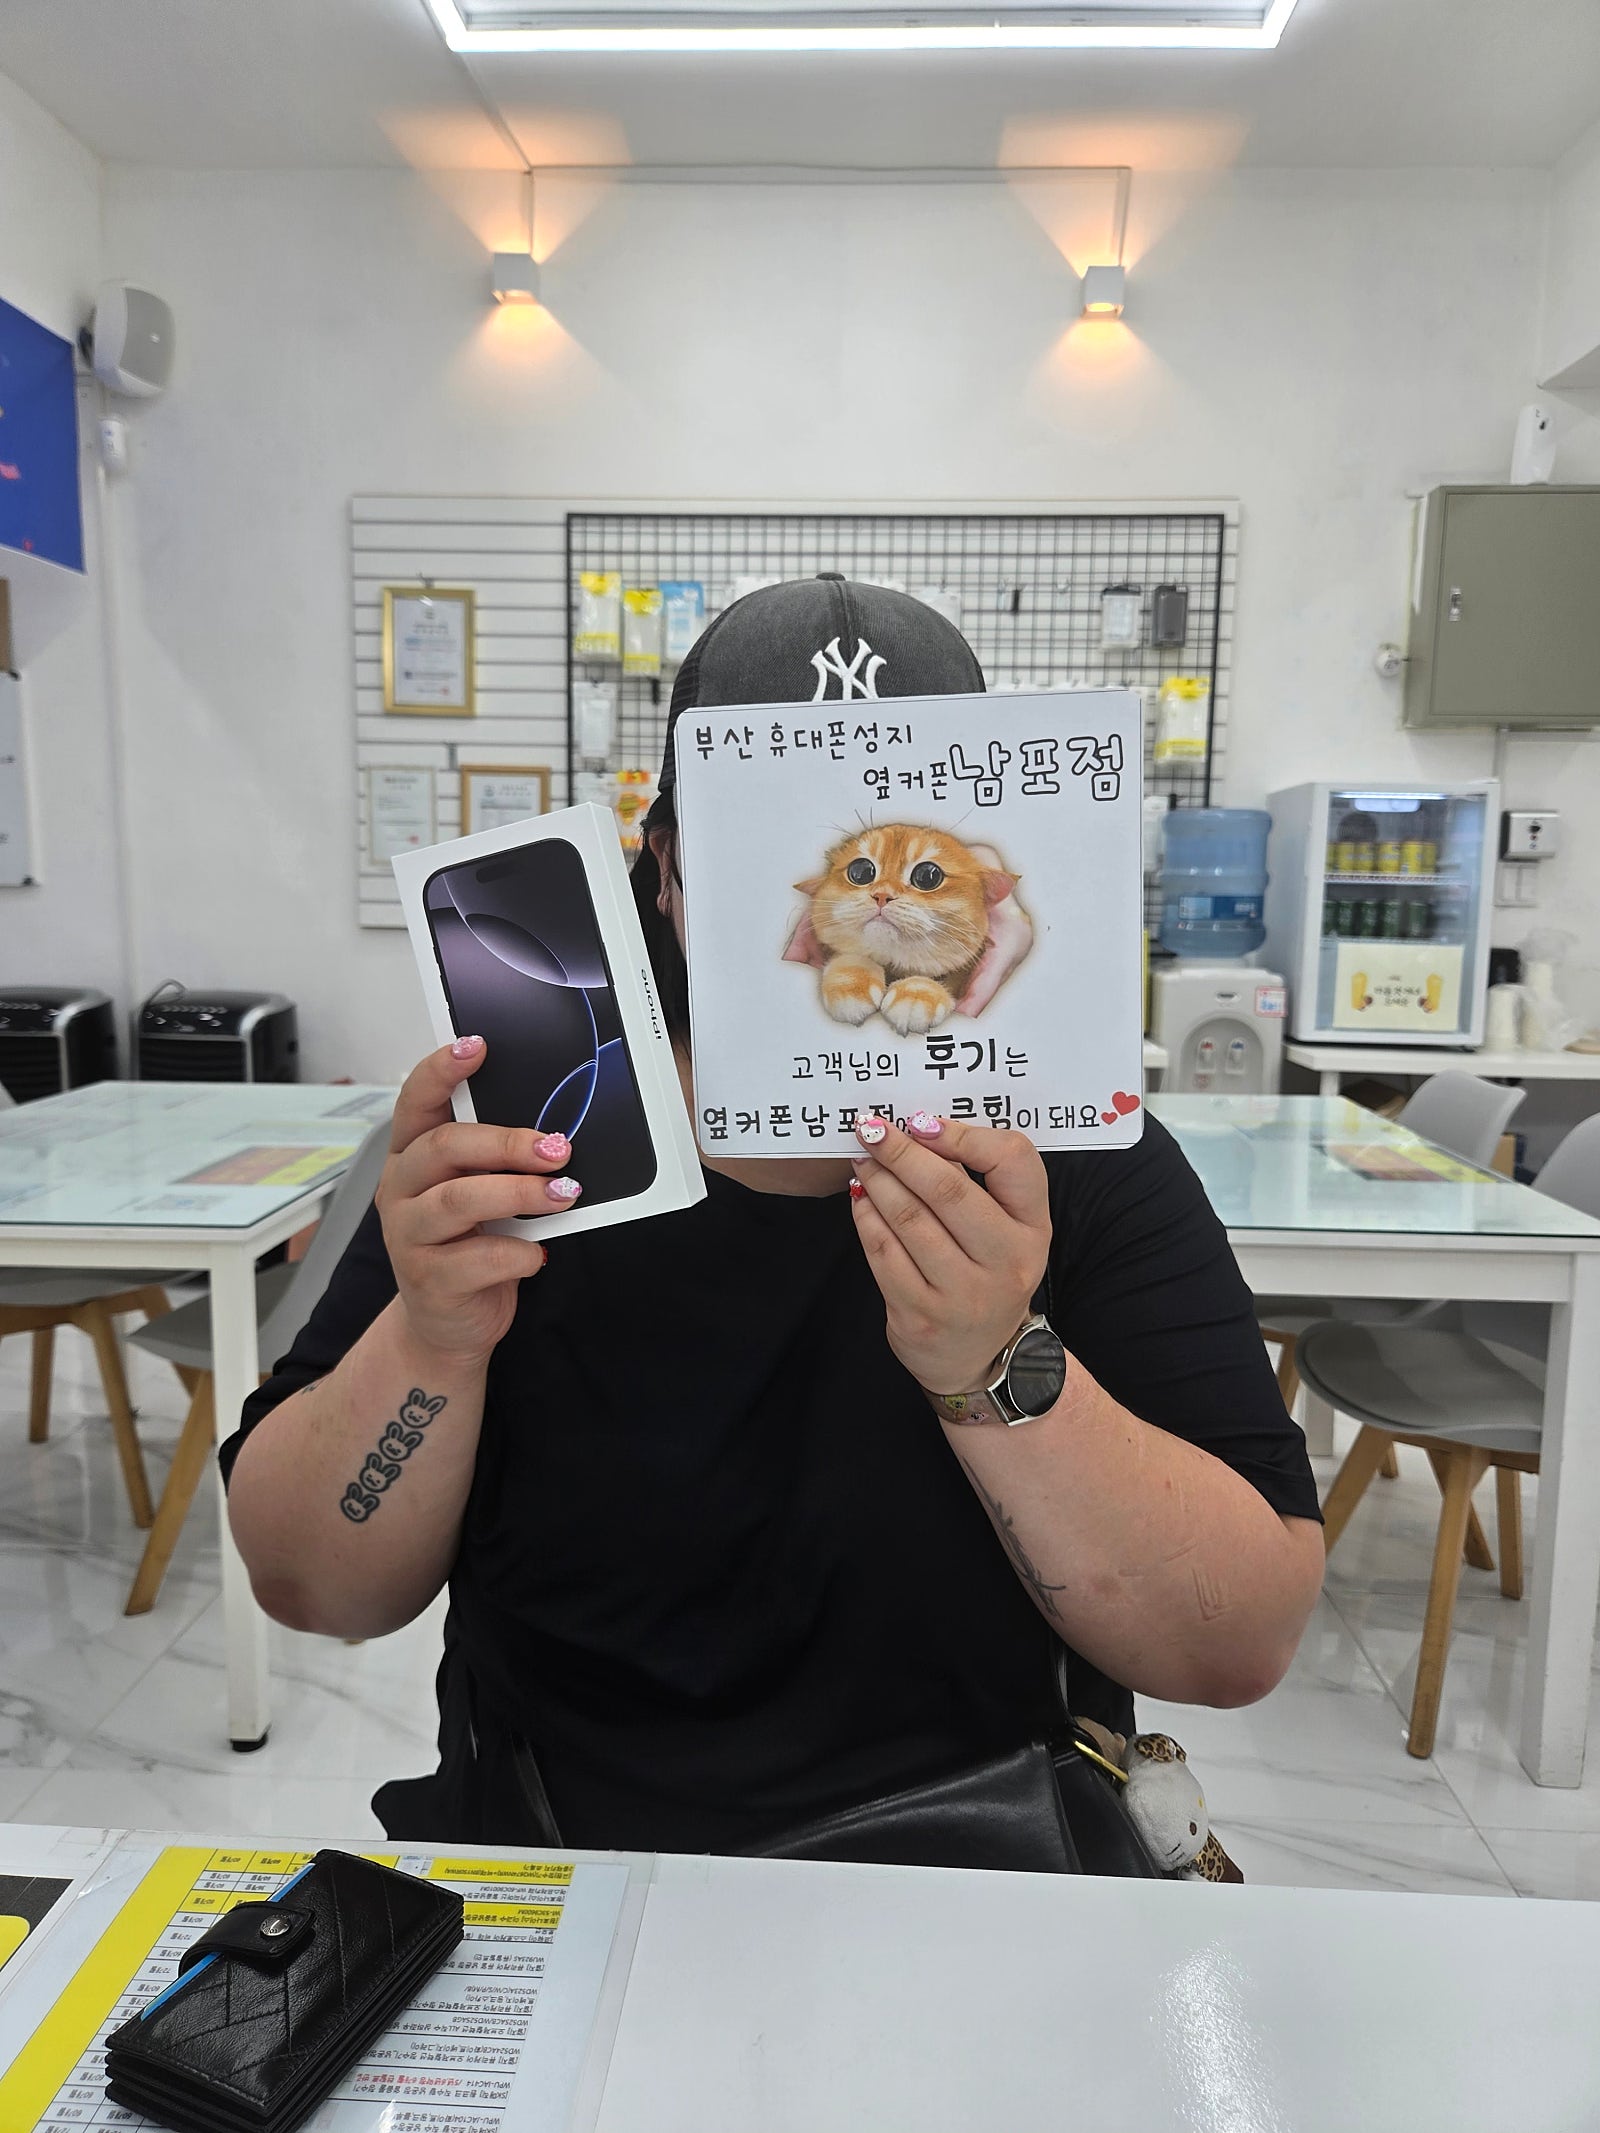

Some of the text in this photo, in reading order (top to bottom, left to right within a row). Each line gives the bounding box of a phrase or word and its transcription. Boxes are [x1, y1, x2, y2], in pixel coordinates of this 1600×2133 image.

[810, 637, 887, 702] NY
[695, 720, 914, 762] 부산 휴대폰성지
[791, 1034, 1029, 1082] 고객님의 후기는
[1048, 1105, 1100, 1130] 돼요
